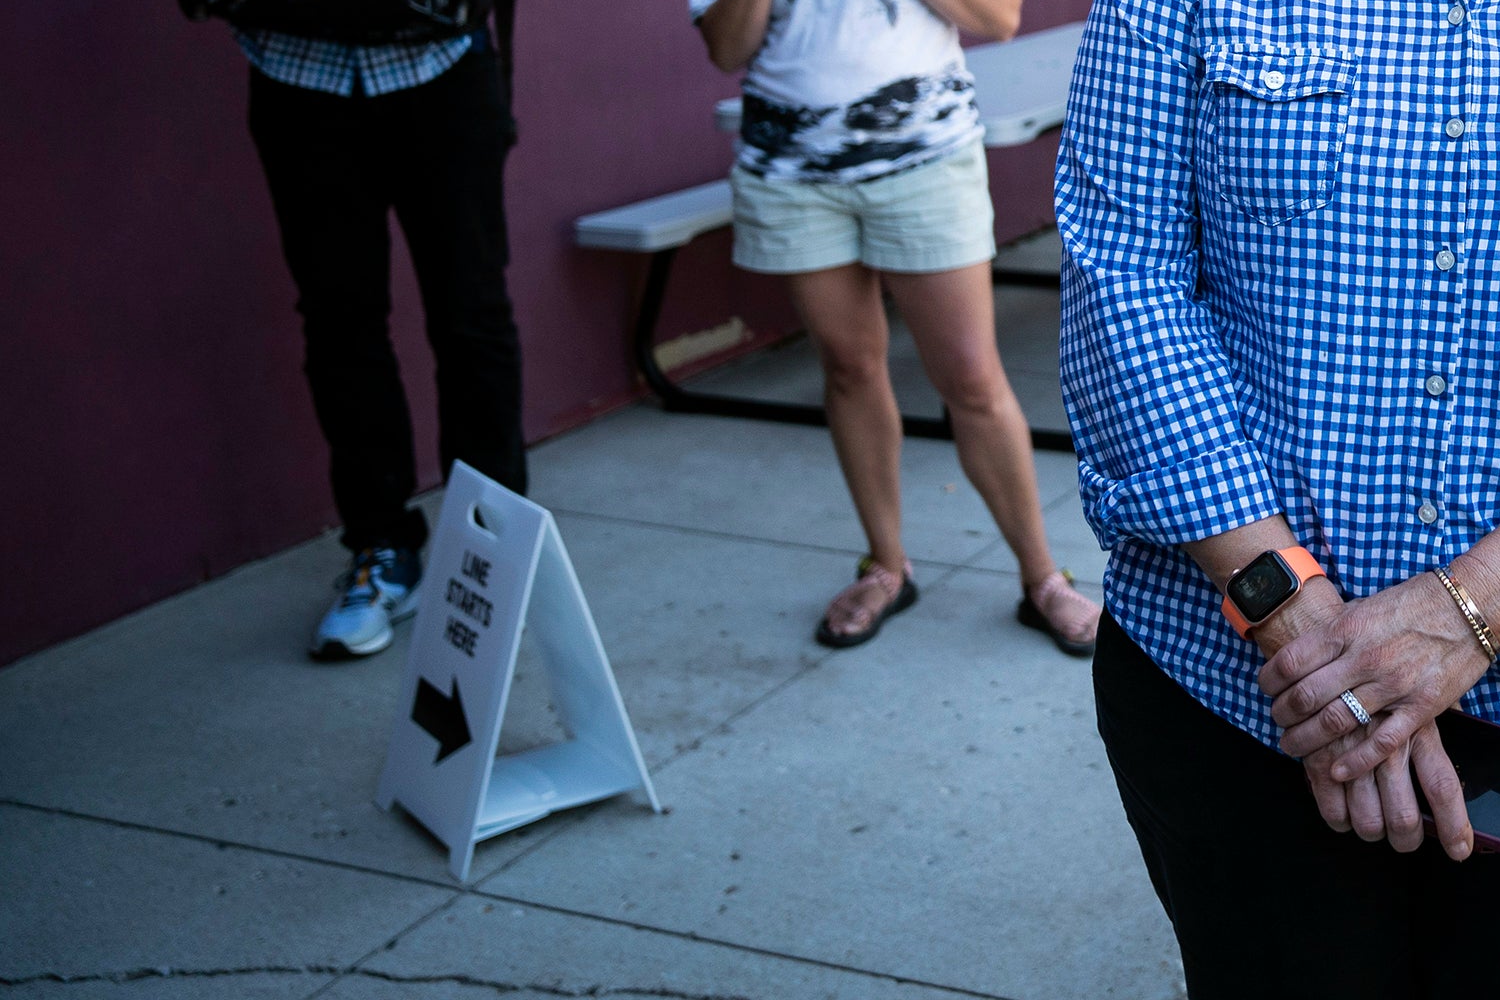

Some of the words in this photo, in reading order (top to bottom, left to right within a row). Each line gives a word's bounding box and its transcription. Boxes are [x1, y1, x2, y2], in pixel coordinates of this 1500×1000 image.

[462, 549, 492, 588] LINE
[446, 577, 494, 628] STARTS
[445, 616, 479, 658] HERE
